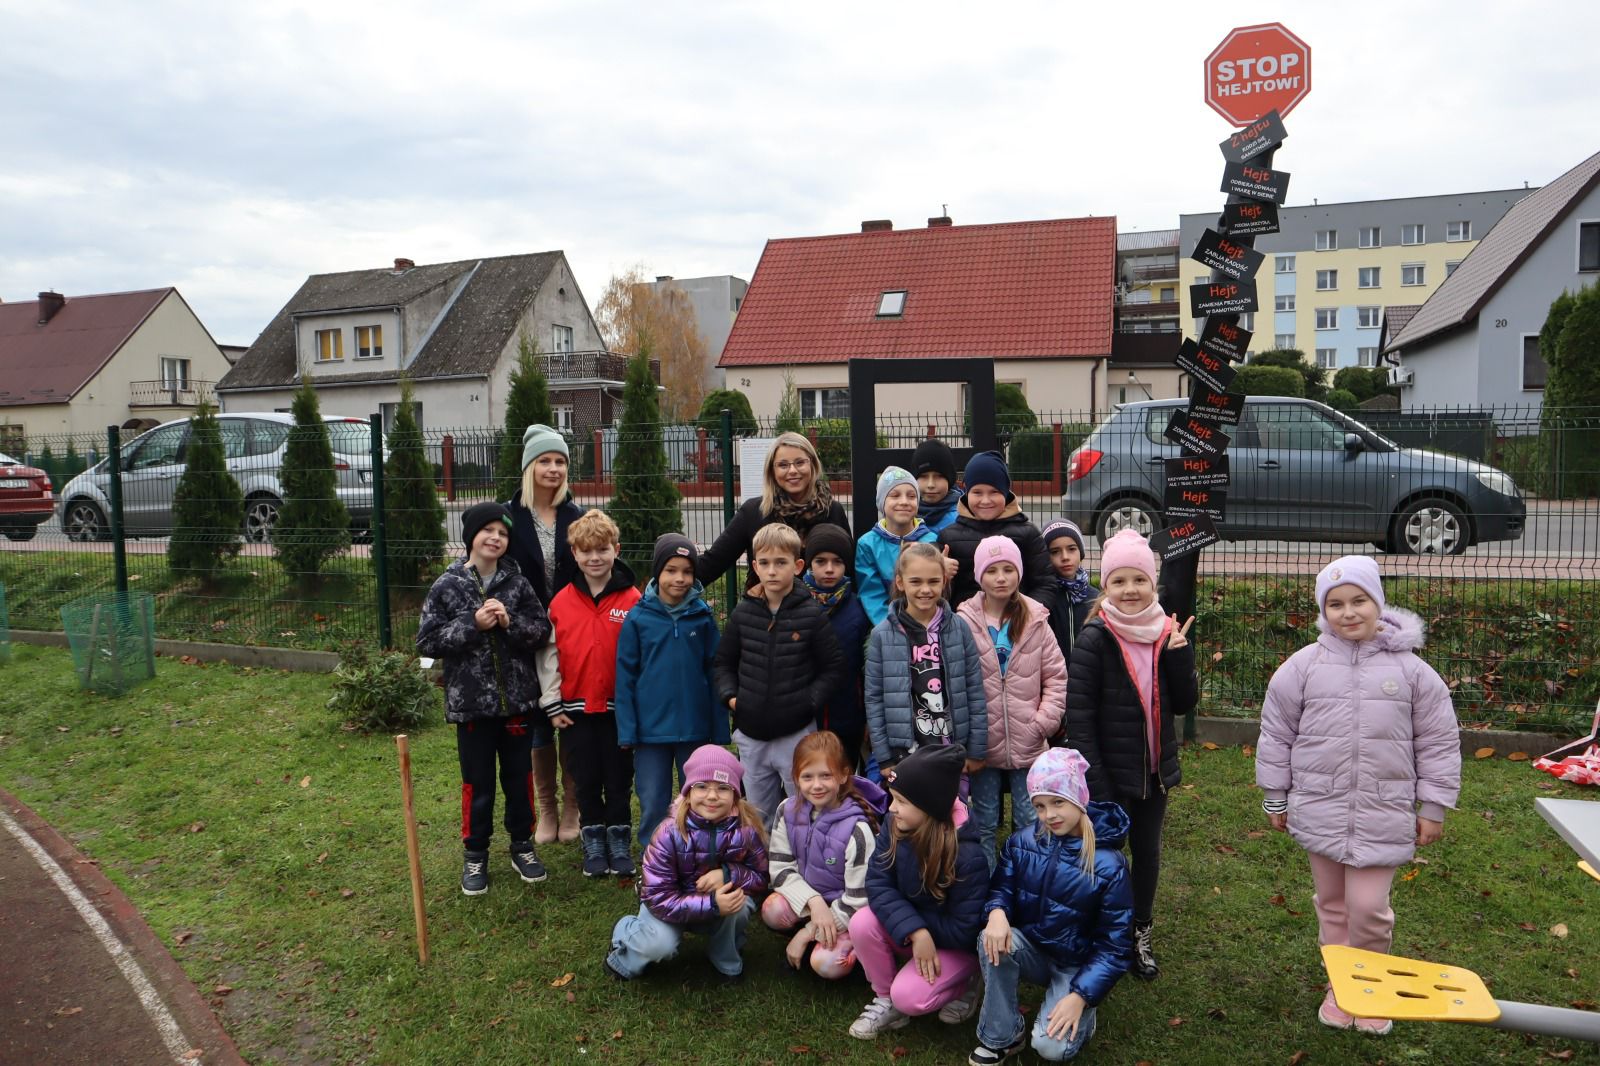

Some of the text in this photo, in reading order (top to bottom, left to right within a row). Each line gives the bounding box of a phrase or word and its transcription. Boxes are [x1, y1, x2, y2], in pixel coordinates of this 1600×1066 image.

[1217, 53, 1299, 81] STOP
[1216, 76, 1301, 97] HEJTOWI
[1231, 120, 1270, 147] Z hejtu
[1230, 179, 1254, 187] ODBIERA
[1242, 166, 1271, 184] Hejt
[1239, 204, 1262, 219] Hejt
[1218, 240, 1245, 259] Hejt
[1205, 249, 1248, 271] ZABIJA RADOŚĆ
[1209, 259, 1225, 269] BYCIA
[1225, 267, 1240, 278] SOBĄ
[1210, 285, 1238, 299] Hejt
[1211, 305, 1245, 313] SAMOTNOŚĆ
[1496, 319, 1507, 327] 20
[1218, 324, 1238, 340] Hejt
[1196, 352, 1220, 371] Hejt
[741, 378, 751, 386] 22
[1206, 393, 1229, 409] Hejt
[1187, 421, 1212, 439] Hejt
[1172, 426, 1217, 453] ZOSTAWIA BLIZNY
[1185, 442, 1203, 454] DUSZY
[1183, 458, 1210, 473] Hejt
[1182, 490, 1209, 506] Hejt
[1170, 522, 1196, 539] Hejt
